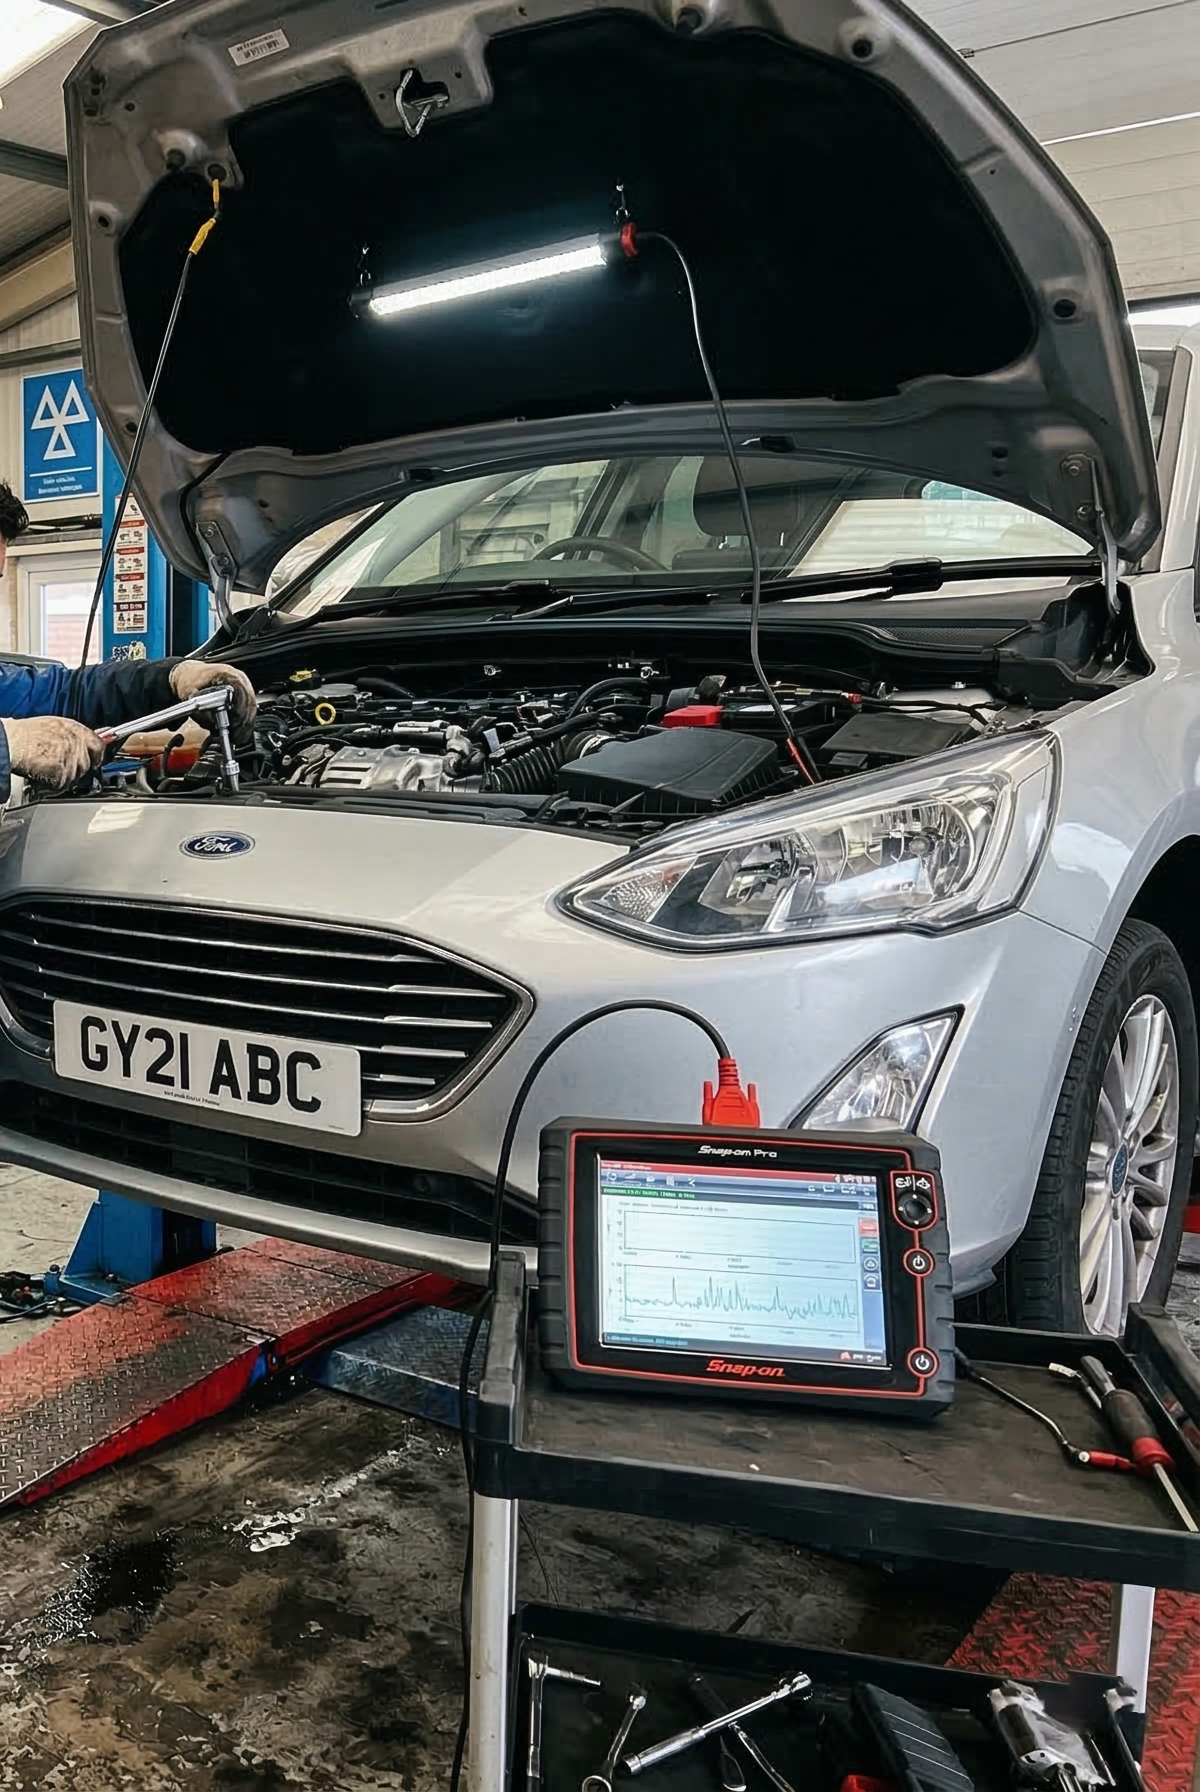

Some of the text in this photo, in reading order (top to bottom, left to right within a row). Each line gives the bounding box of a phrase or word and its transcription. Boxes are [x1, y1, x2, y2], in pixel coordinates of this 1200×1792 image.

[193, 836, 238, 853] Ford
[79, 1014, 322, 1114] GY21 ABC
